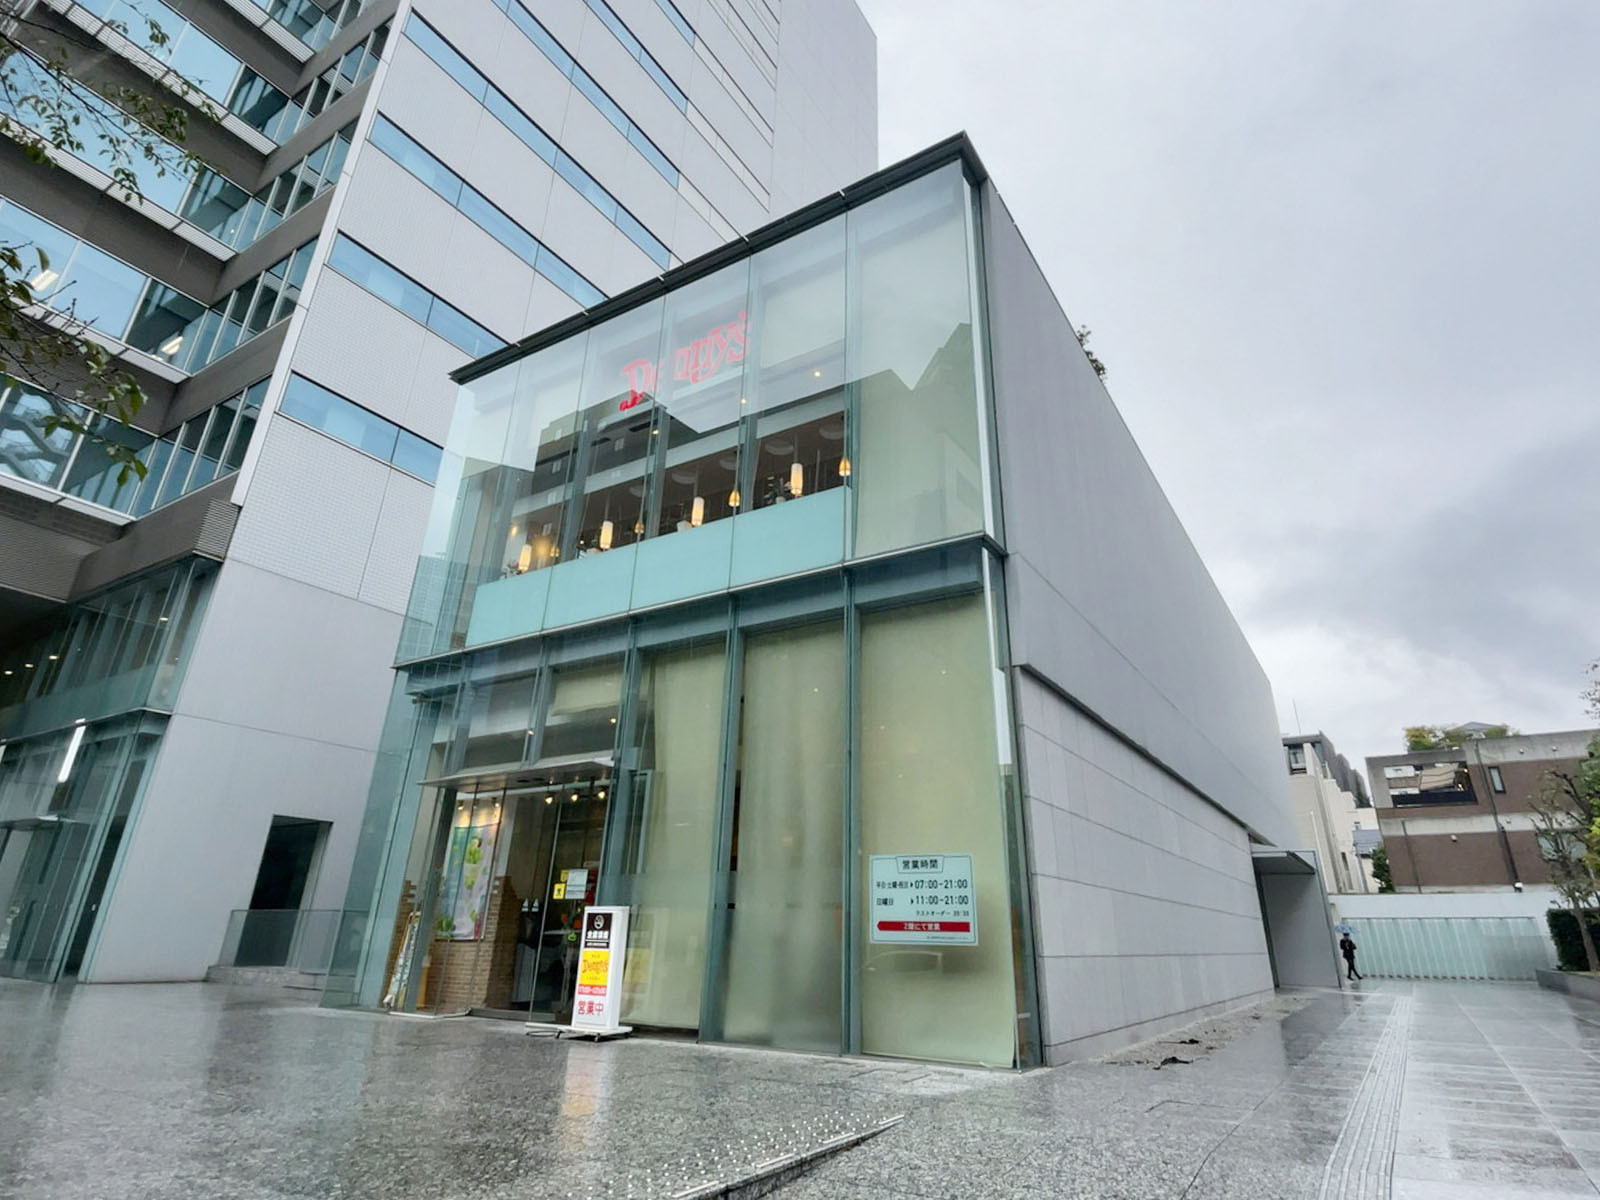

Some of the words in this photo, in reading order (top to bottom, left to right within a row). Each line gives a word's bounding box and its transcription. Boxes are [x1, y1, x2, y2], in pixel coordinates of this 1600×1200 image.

[902, 859, 939, 870] 営業時間
[578, 1000, 604, 1015] 営業中
